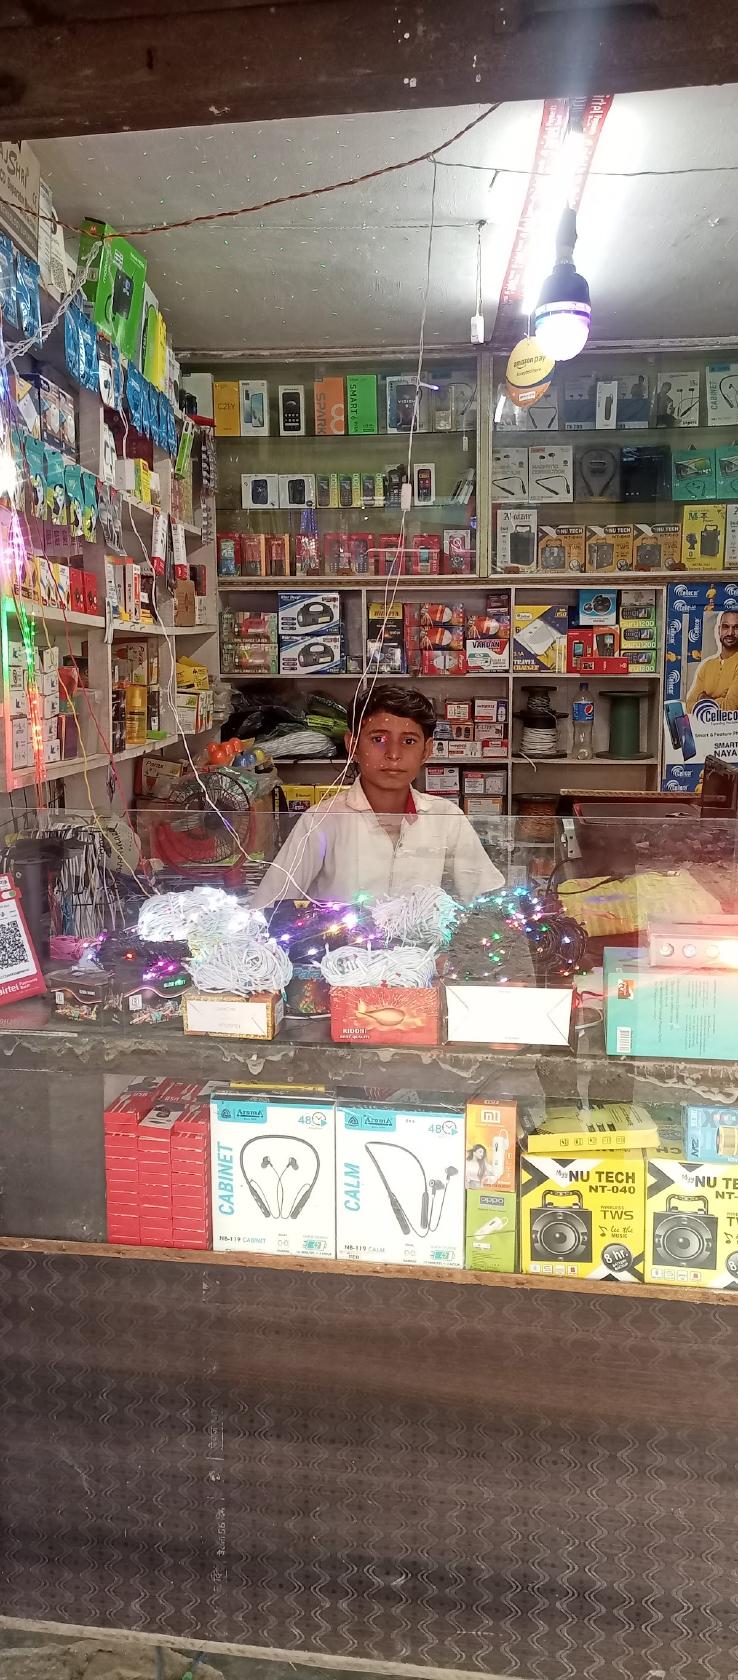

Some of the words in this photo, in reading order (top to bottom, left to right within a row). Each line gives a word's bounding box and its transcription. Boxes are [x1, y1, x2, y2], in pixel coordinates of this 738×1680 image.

[534, 355, 546, 364] pay
[350, 384, 358, 414] SMART
[709, 380, 718, 410] CABINET
[317, 393, 327, 434] SPARK
[705, 710, 738, 722] Celleco
[714, 742, 738, 750] SMART
[714, 749, 738, 757] NAYA
[298, 1115, 312, 1125] 48
[429, 1124, 442, 1134] 48
[218, 1142, 235, 1217] CABINET
[569, 1170, 590, 1182] NU
[595, 1171, 636, 1184] TECH
[695, 1176, 717, 1188] NU
[344, 1162, 361, 1212] CALM
[589, 1185, 636, 1194] NT-040
[600, 1210, 634, 1220] TWS
[604, 1253, 613, 1264] 8
[612, 1249, 629, 1261] hr.
[728, 1261, 737, 1271] 8
